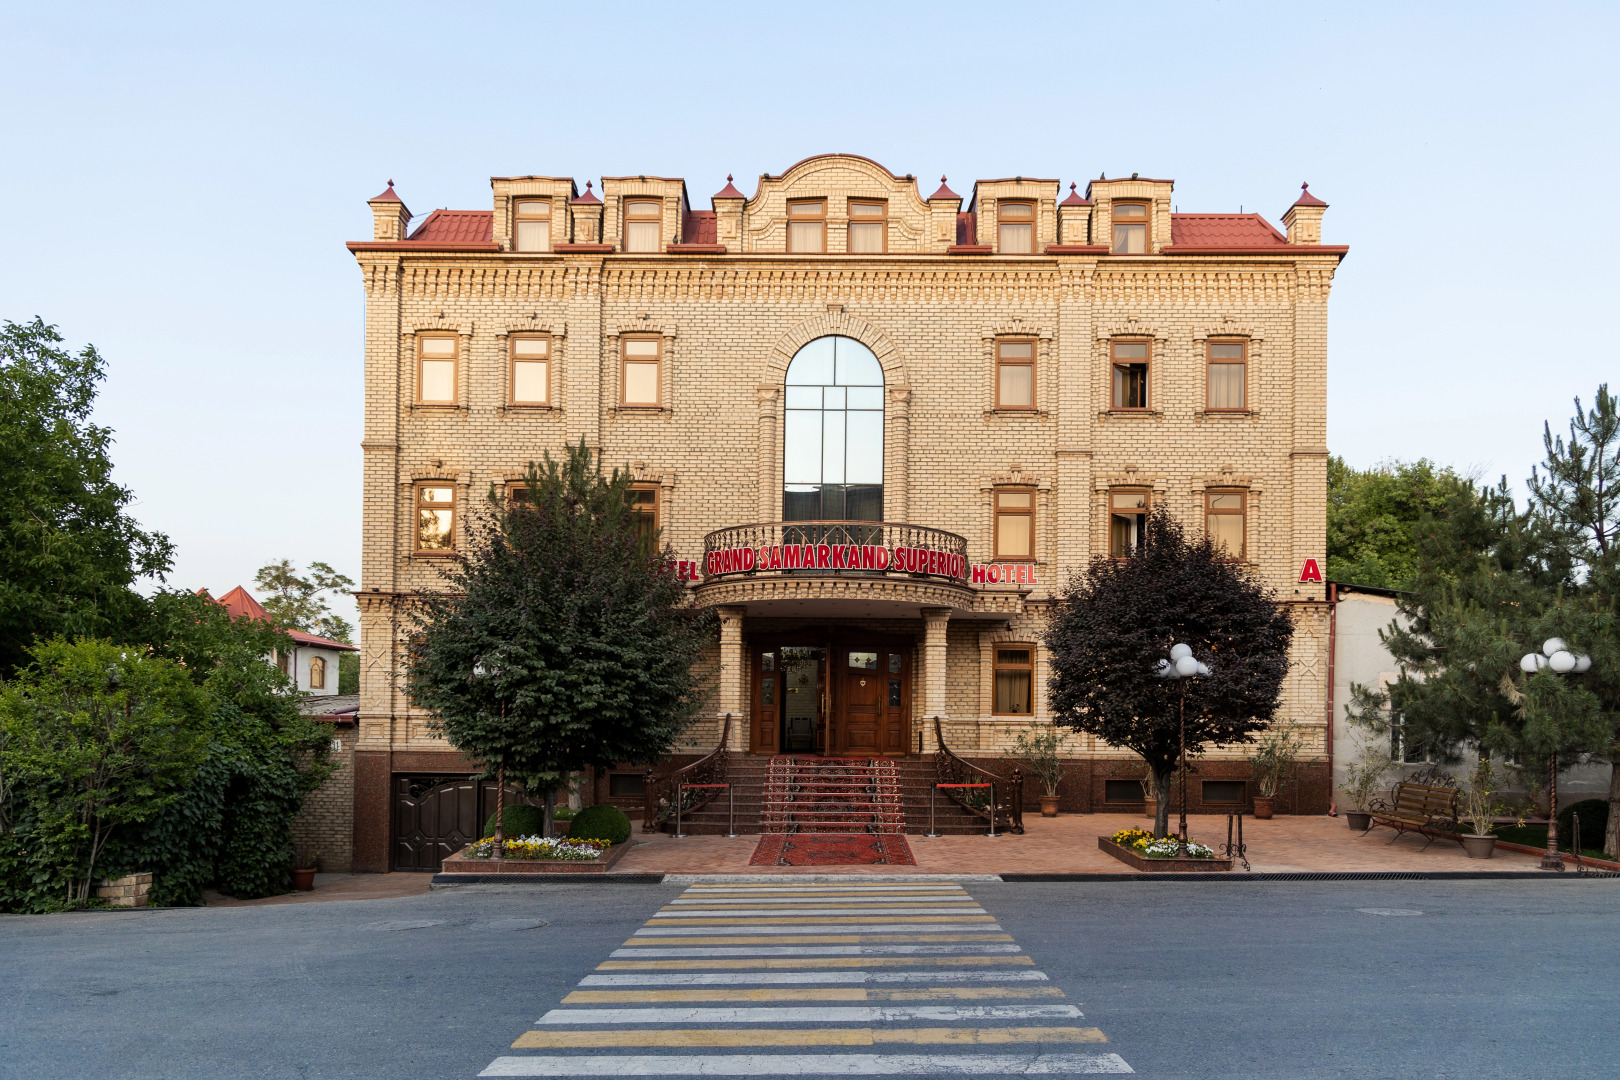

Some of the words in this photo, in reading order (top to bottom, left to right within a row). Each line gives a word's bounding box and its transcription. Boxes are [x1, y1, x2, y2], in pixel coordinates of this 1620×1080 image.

[707, 547, 757, 575] GRAND
[758, 543, 889, 570] SAMARKAND
[893, 546, 966, 579] SUPERIOR
[1298, 557, 1323, 582] A
[972, 564, 1039, 584] HOTEL
